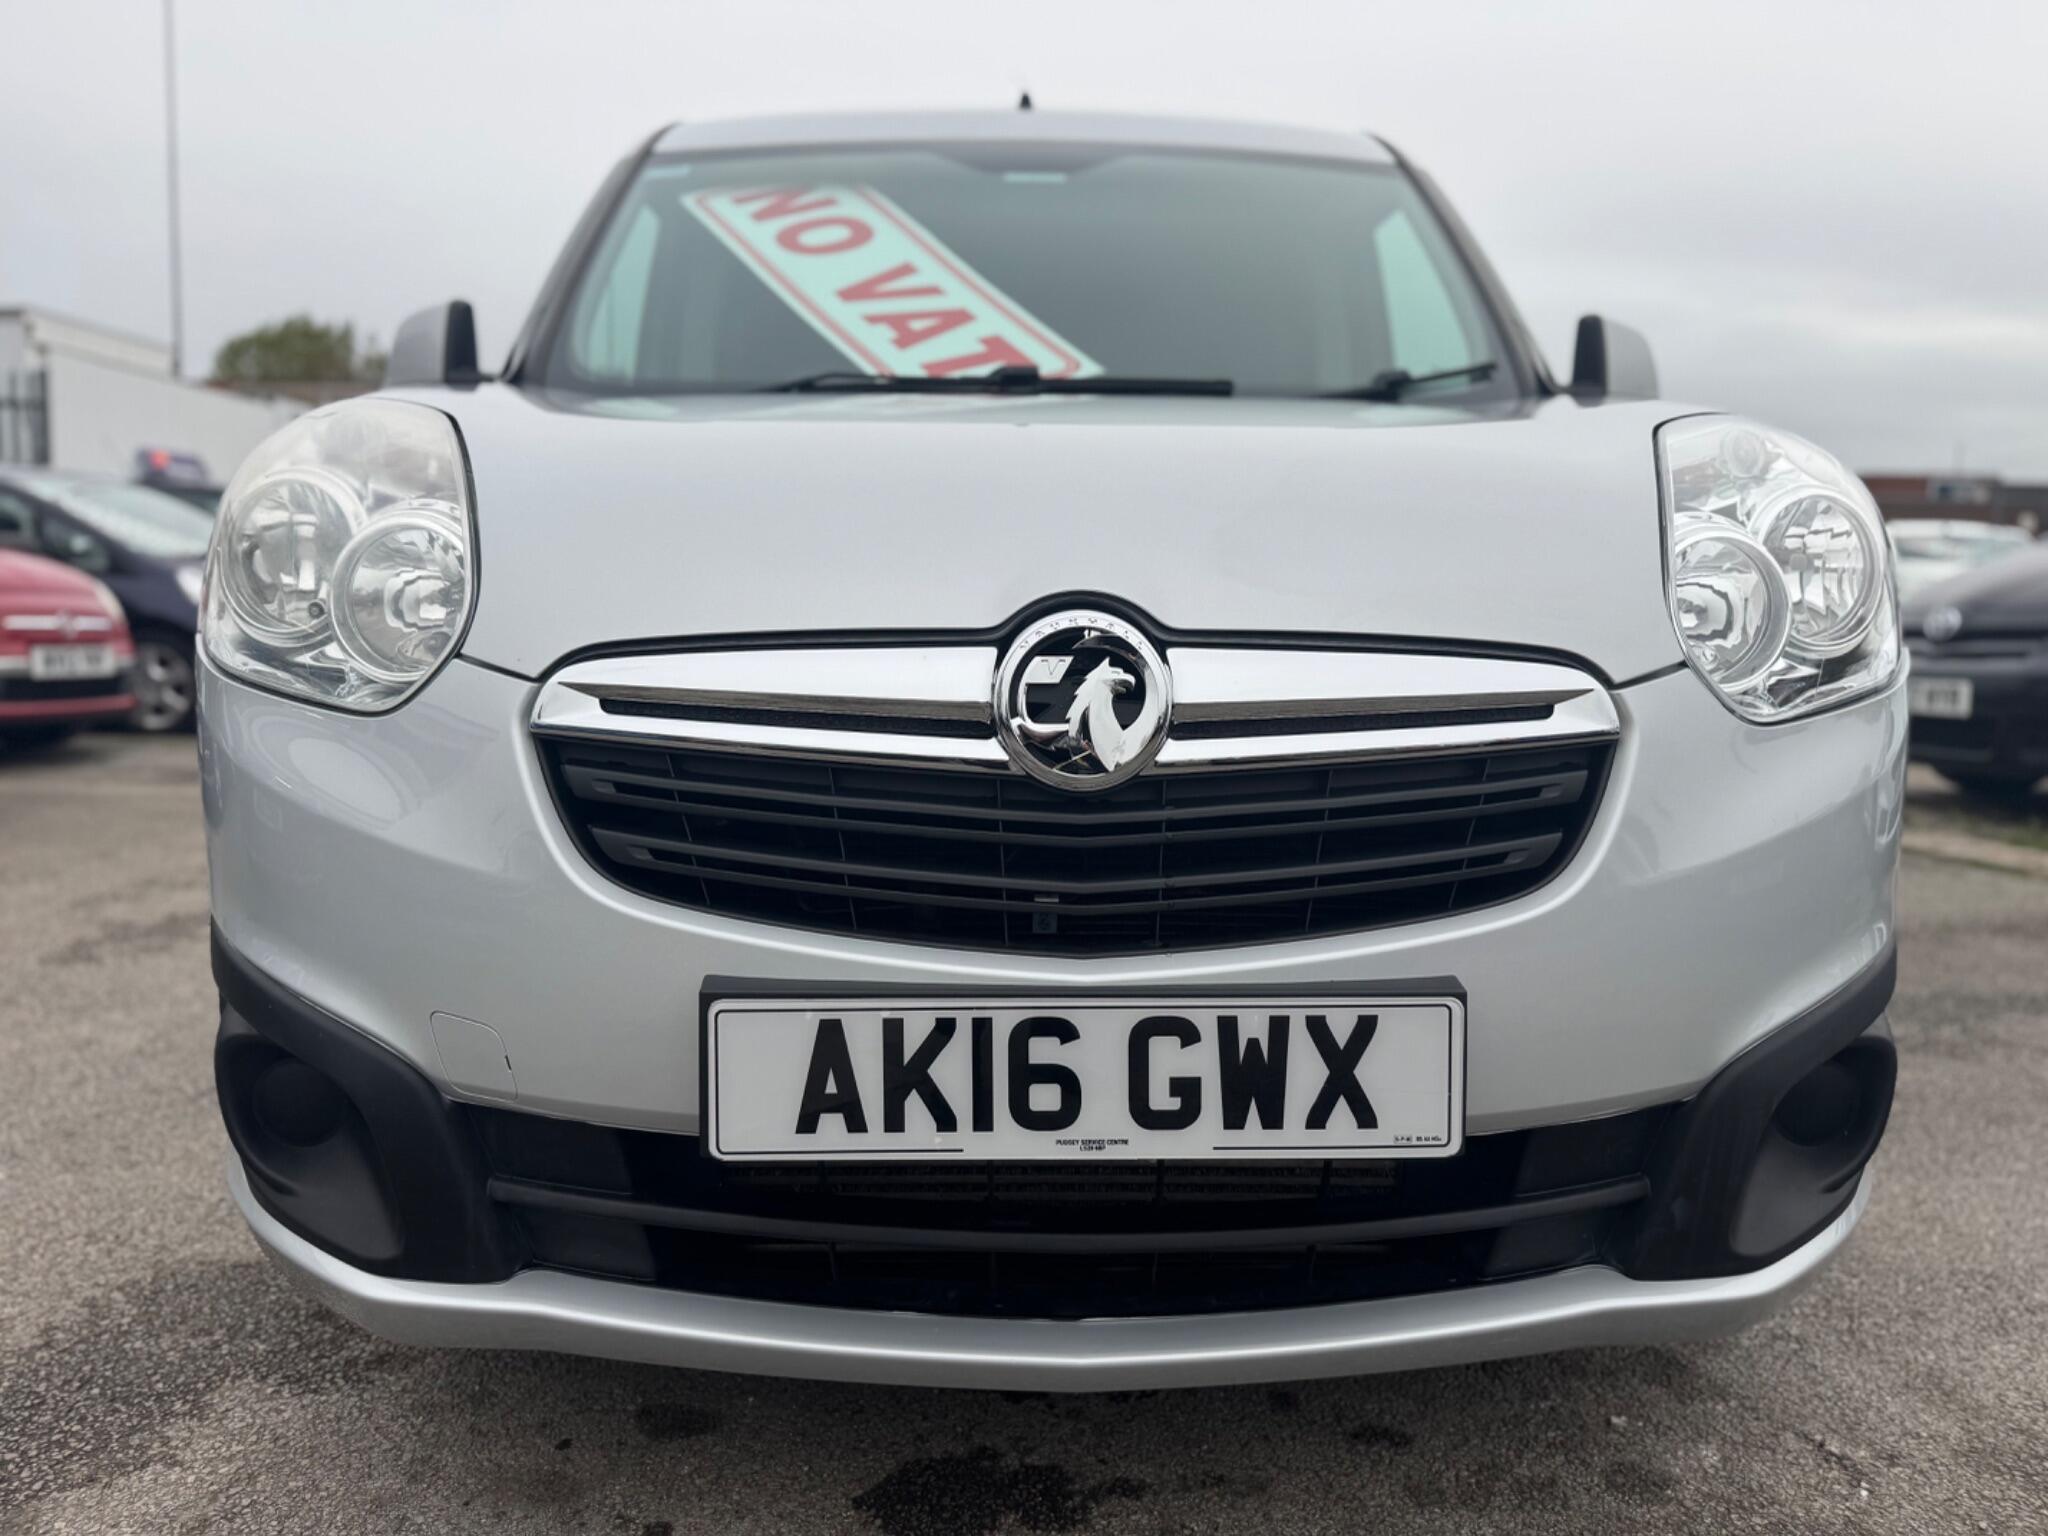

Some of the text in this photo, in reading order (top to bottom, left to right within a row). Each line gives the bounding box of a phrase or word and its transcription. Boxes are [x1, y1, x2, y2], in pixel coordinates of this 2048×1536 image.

[731, 186, 1038, 379] NO VAT
[795, 1014, 1379, 1134] AK16 GWX
